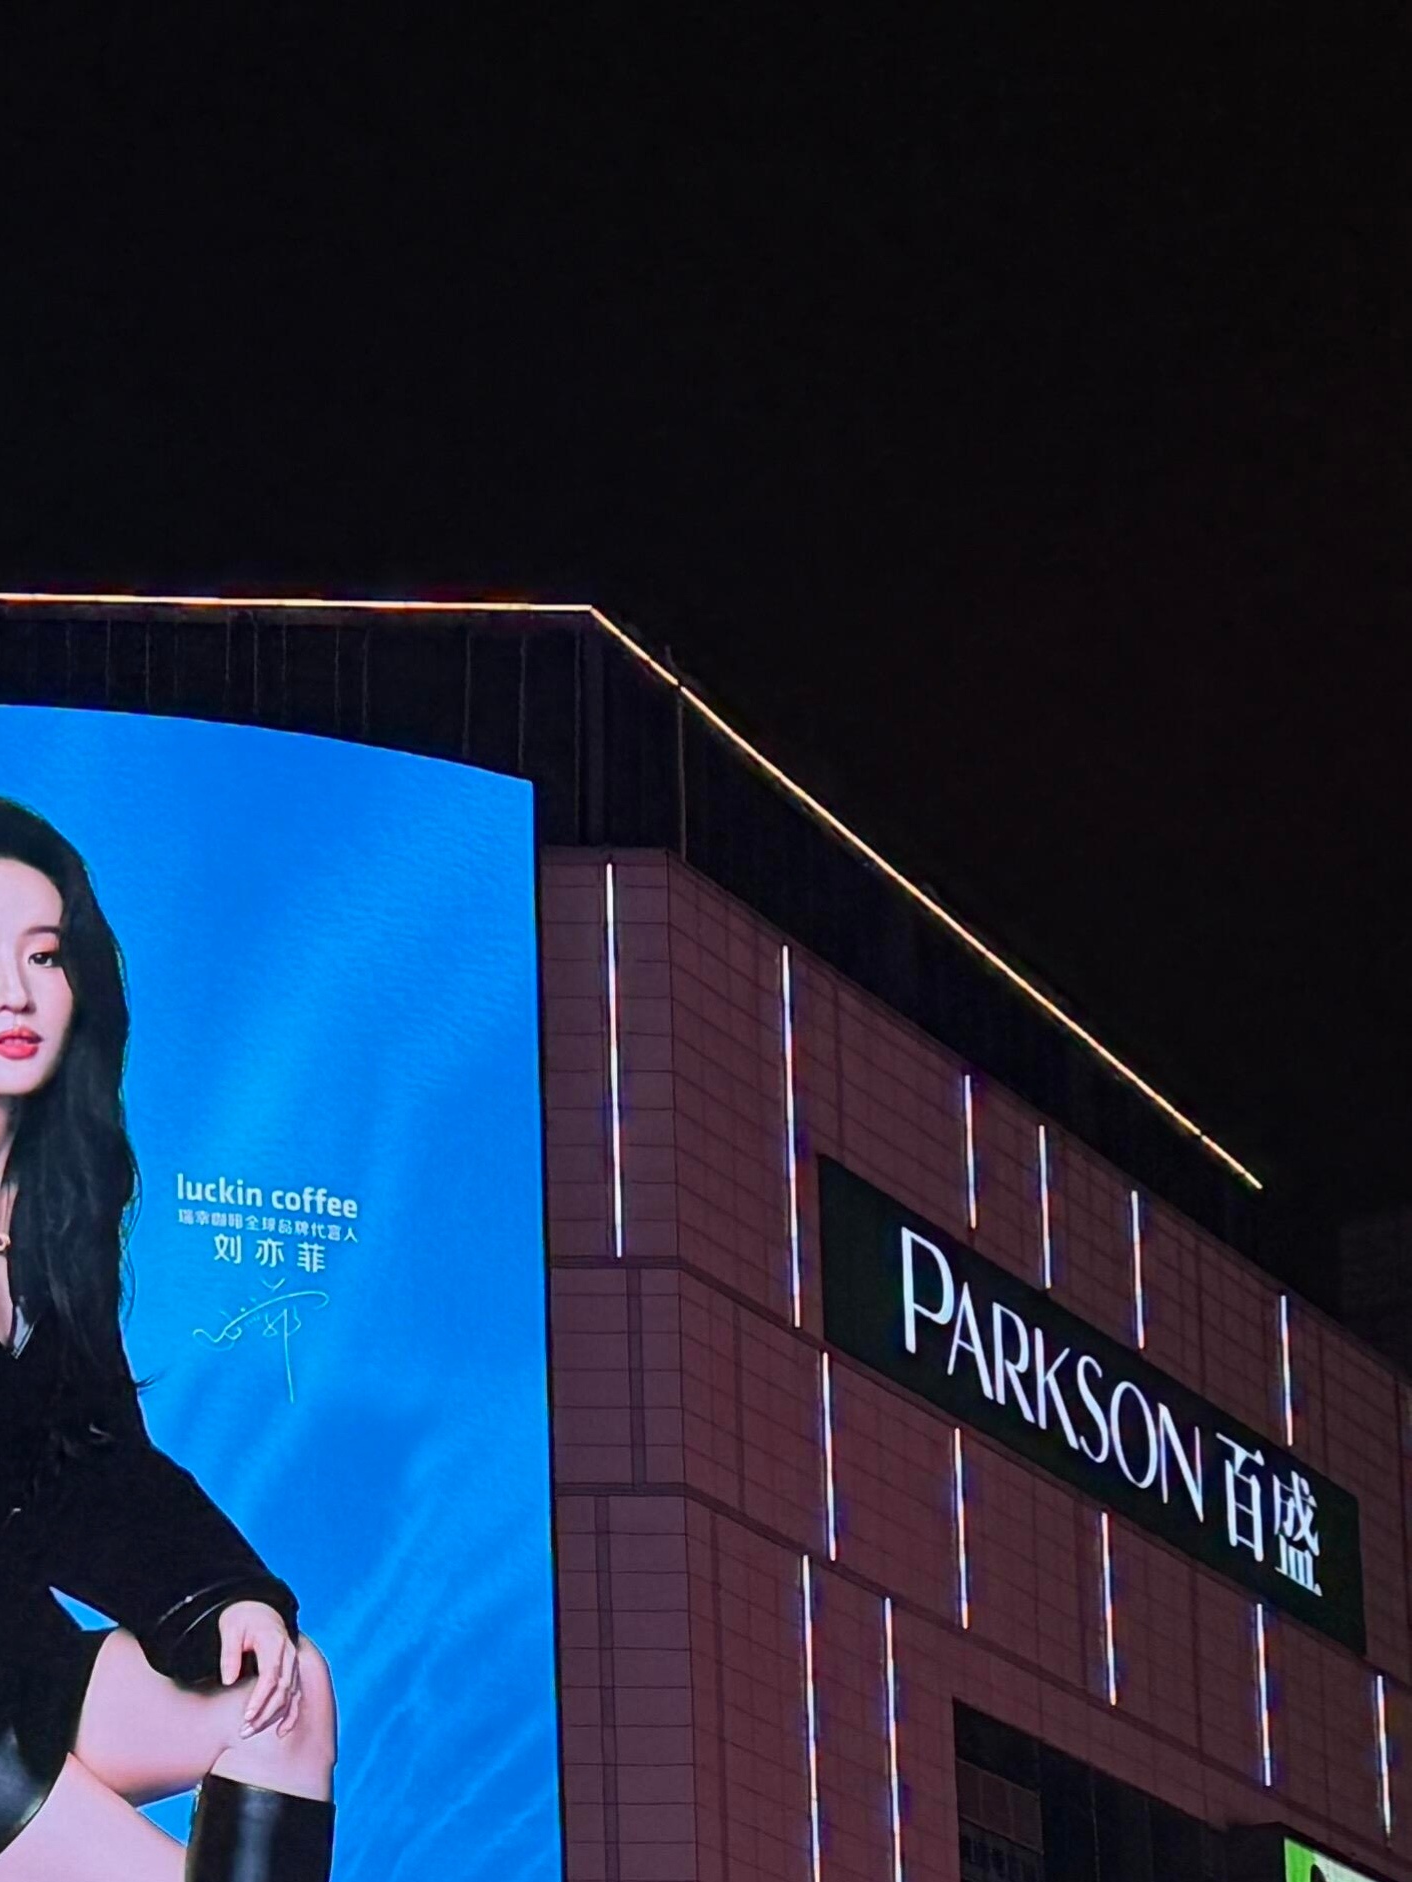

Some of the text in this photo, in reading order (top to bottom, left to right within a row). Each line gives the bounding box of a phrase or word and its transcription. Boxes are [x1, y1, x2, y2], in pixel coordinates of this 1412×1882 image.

[177, 1173, 358, 1219] luckin coffee
[213, 1233, 326, 1273] 刘亦菲
[900, 1226, 1323, 1598] PARKSON 百盛
